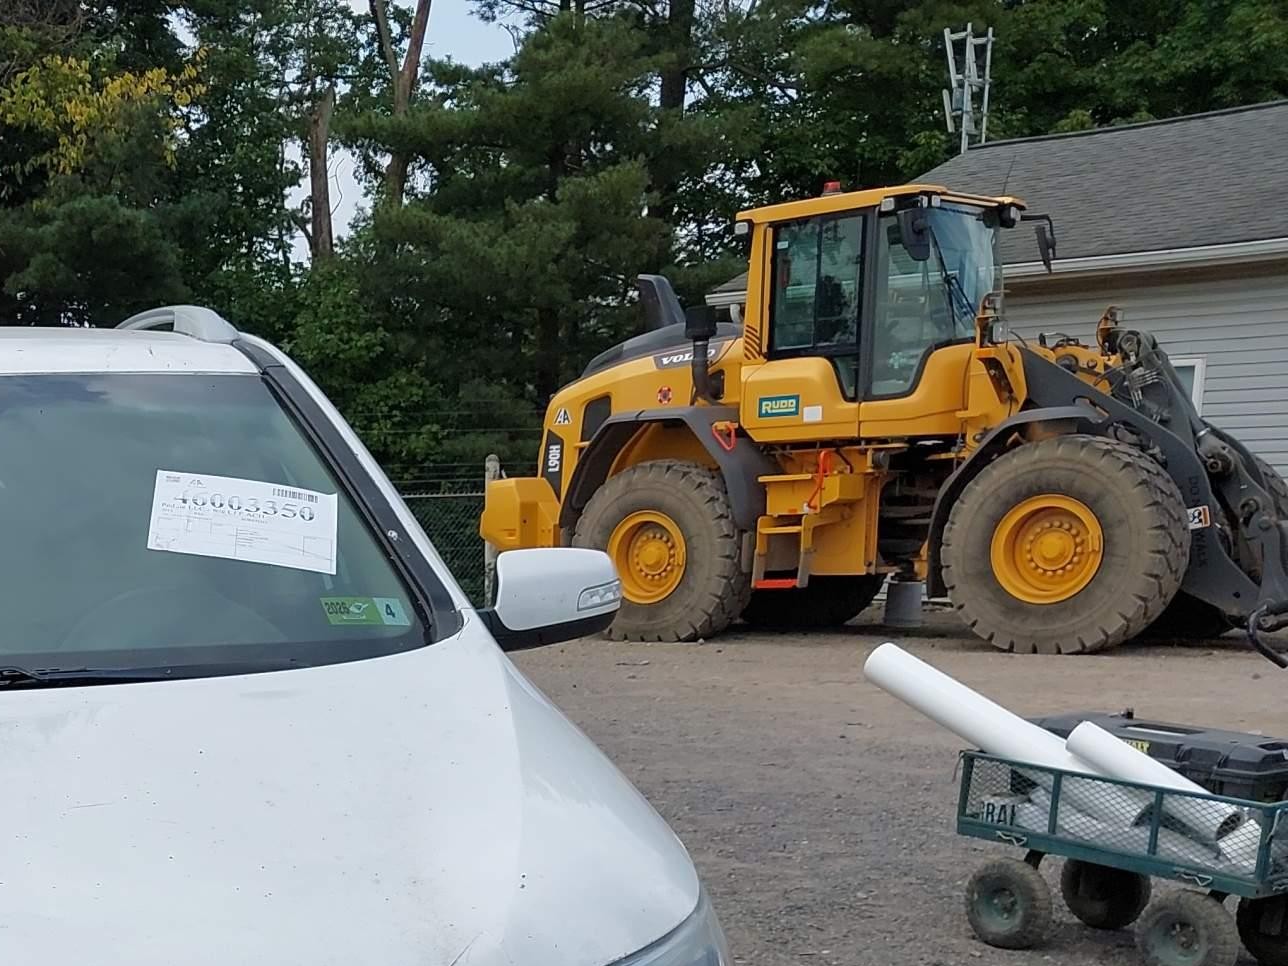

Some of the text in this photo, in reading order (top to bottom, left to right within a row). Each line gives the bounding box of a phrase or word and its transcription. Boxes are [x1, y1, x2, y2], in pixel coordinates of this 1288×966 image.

[661, 349, 716, 365] VOLO
[762, 399, 795, 413] RUDD
[548, 444, 561, 472] L90H
[174, 489, 315, 521] 46003350
[385, 603, 396, 618] 4
